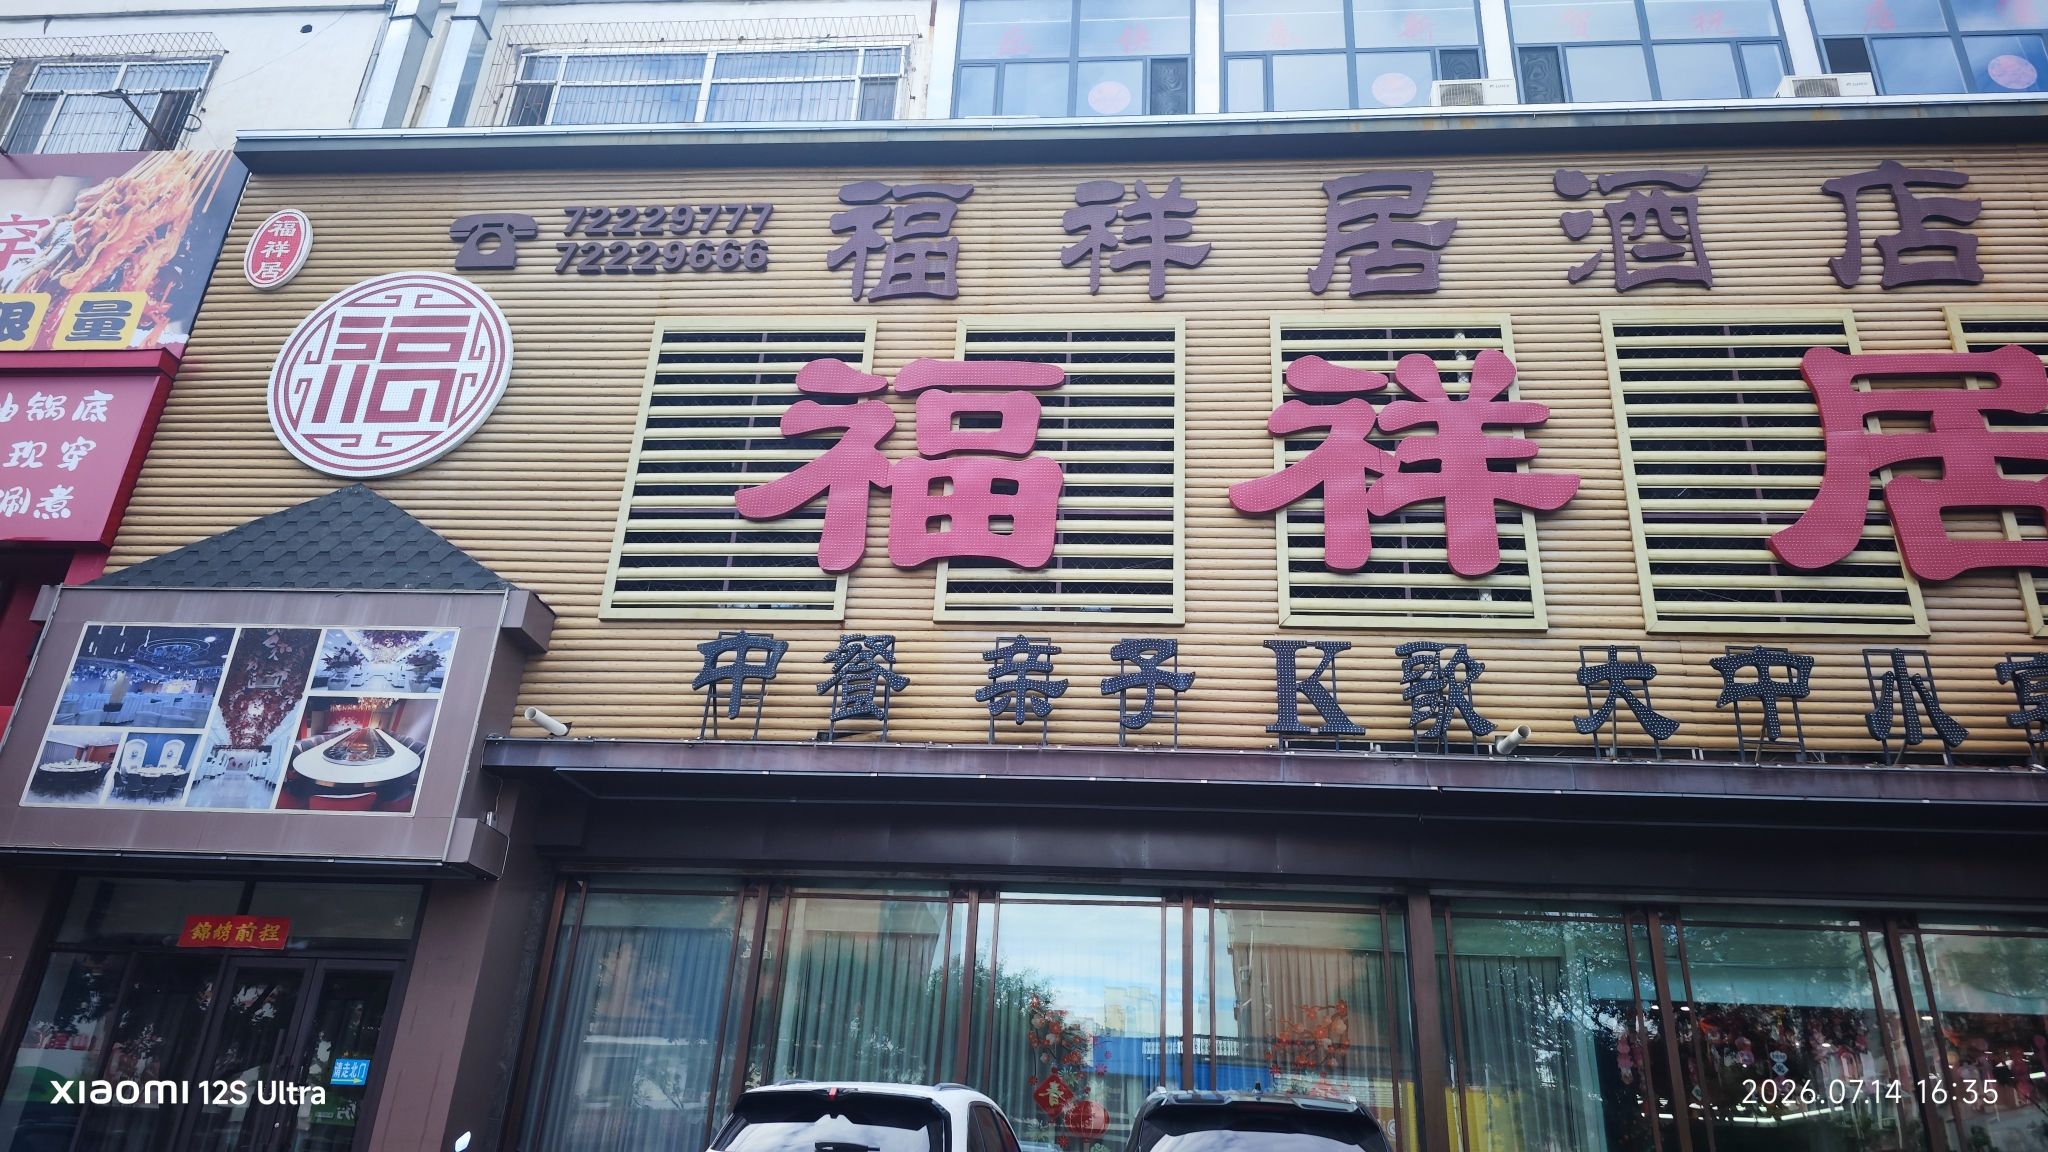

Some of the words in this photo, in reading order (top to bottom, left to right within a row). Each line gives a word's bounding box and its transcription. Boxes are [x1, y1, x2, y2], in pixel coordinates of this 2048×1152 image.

[253, 220, 299, 280] 福祥居
[564, 203, 774, 237] 72229777
[827, 160, 1985, 301] 福祥居酒店
[555, 240, 769, 275] 72229666
[735, 344, 2048, 582] 福祥居
